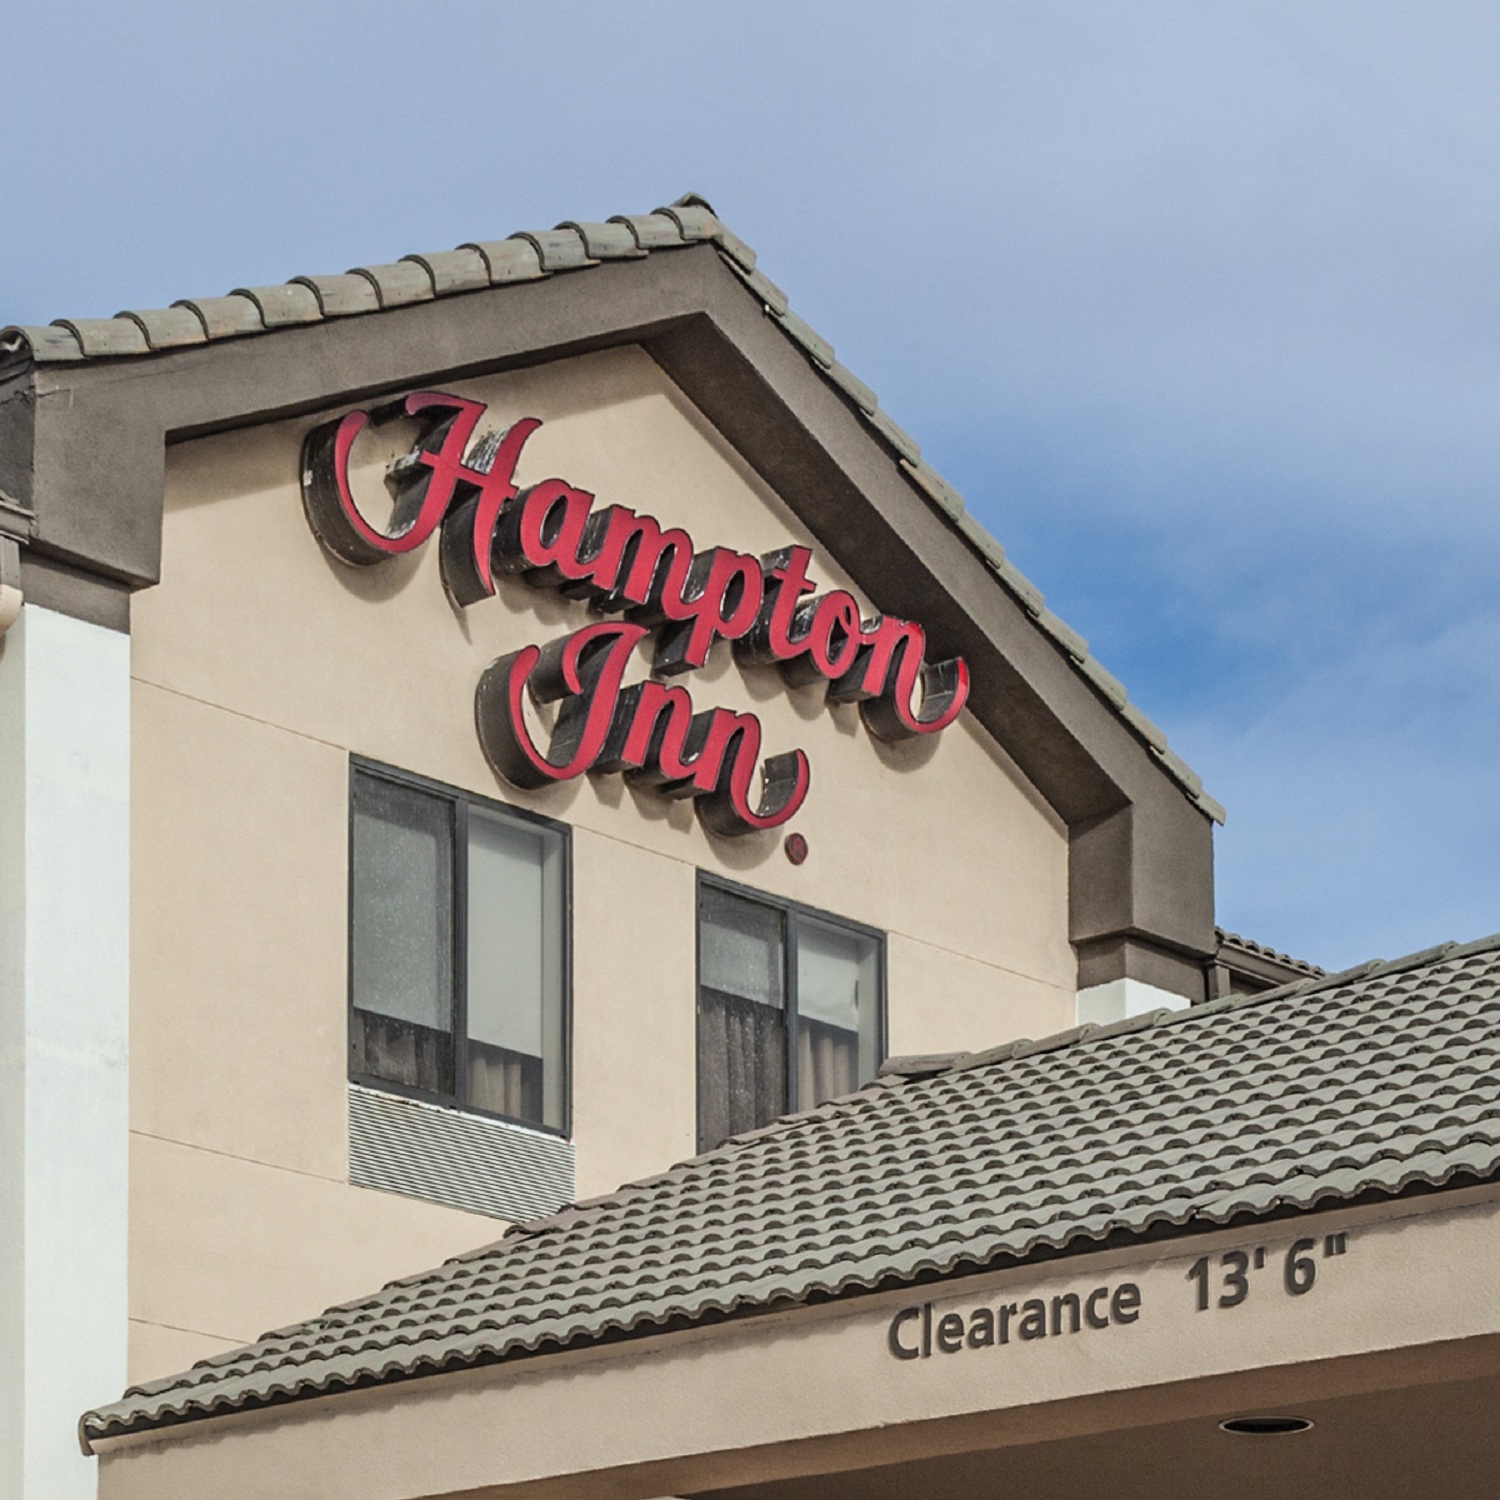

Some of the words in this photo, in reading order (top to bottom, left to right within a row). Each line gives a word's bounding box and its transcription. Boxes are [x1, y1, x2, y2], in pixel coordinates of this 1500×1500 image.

[303, 391, 971, 740] Hampton
[474, 620, 812, 836] Inn
[887, 1279, 1143, 1361] Clearance
